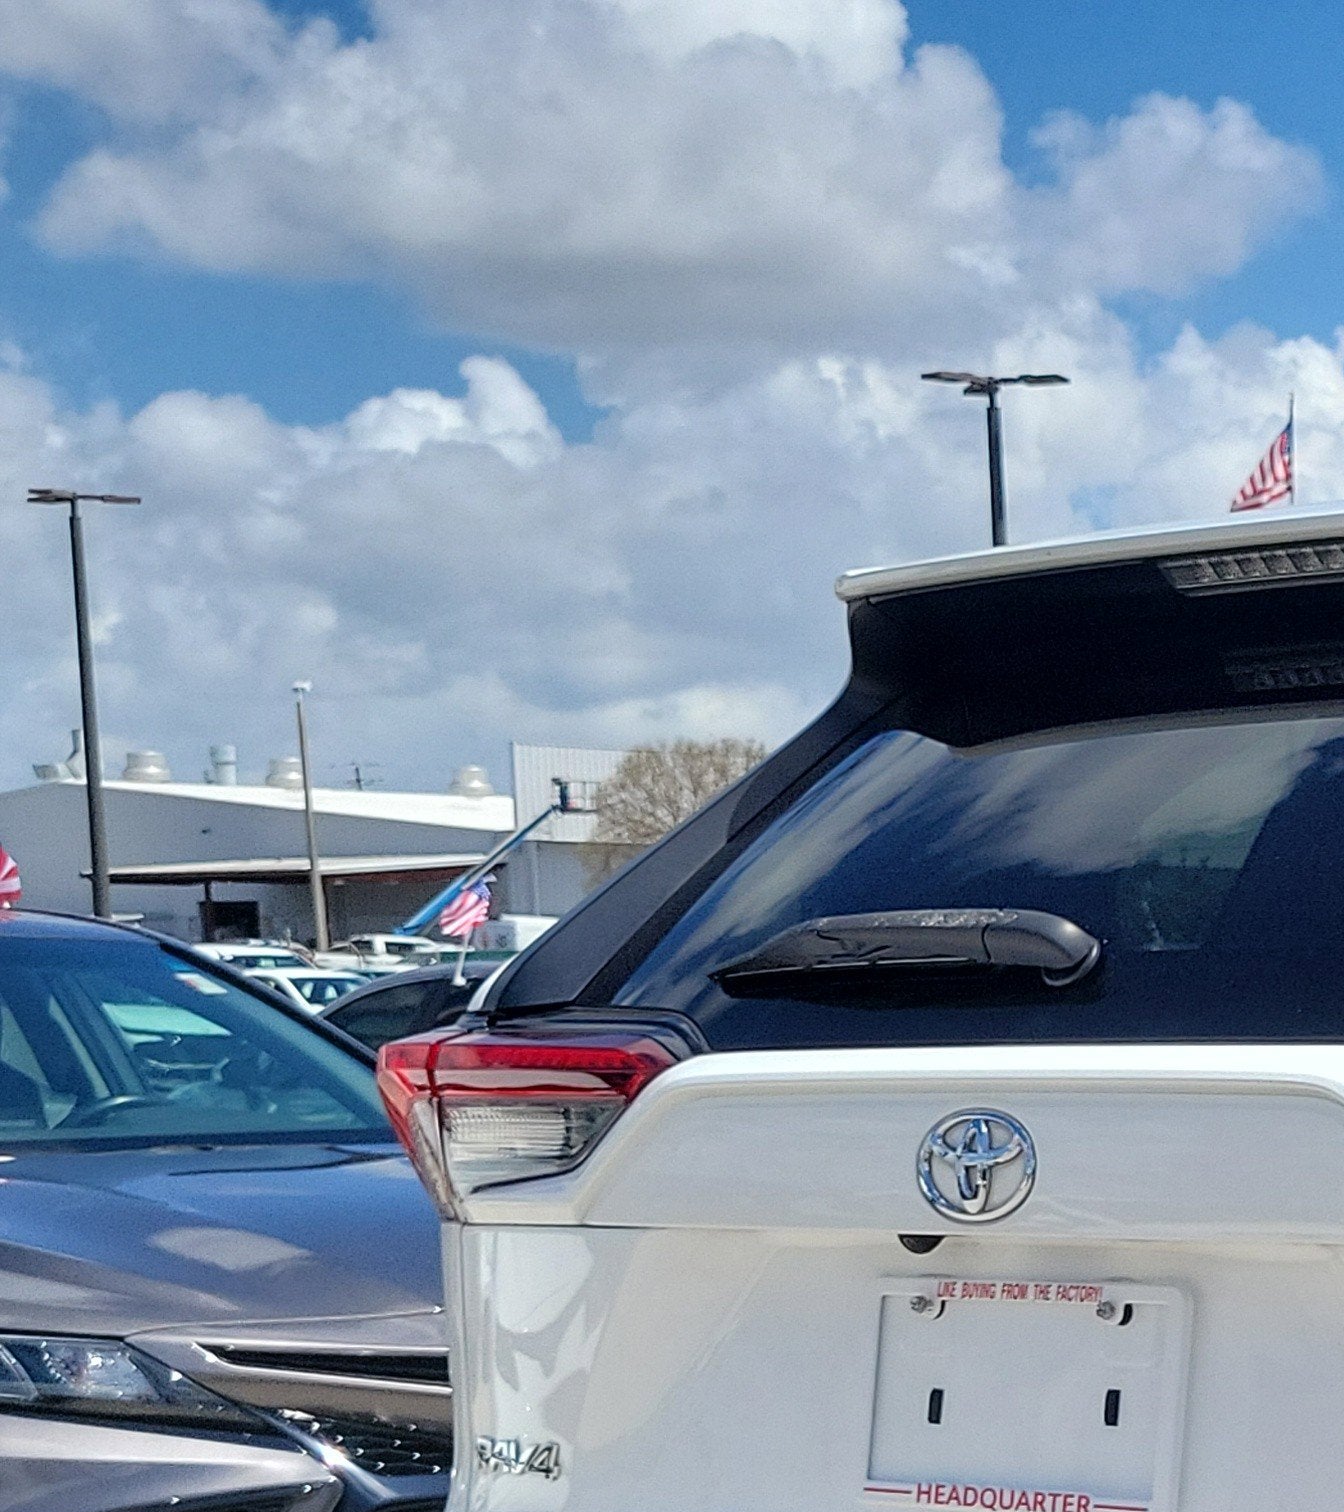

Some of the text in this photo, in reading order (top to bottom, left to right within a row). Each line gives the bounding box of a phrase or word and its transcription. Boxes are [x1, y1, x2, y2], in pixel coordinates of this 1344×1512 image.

[937, 1281, 957, 1298] LIKE
[961, 1282, 996, 1300] BUYING
[1001, 1283, 1029, 1300] FROM
[1034, 1284, 1052, 1301] THE
